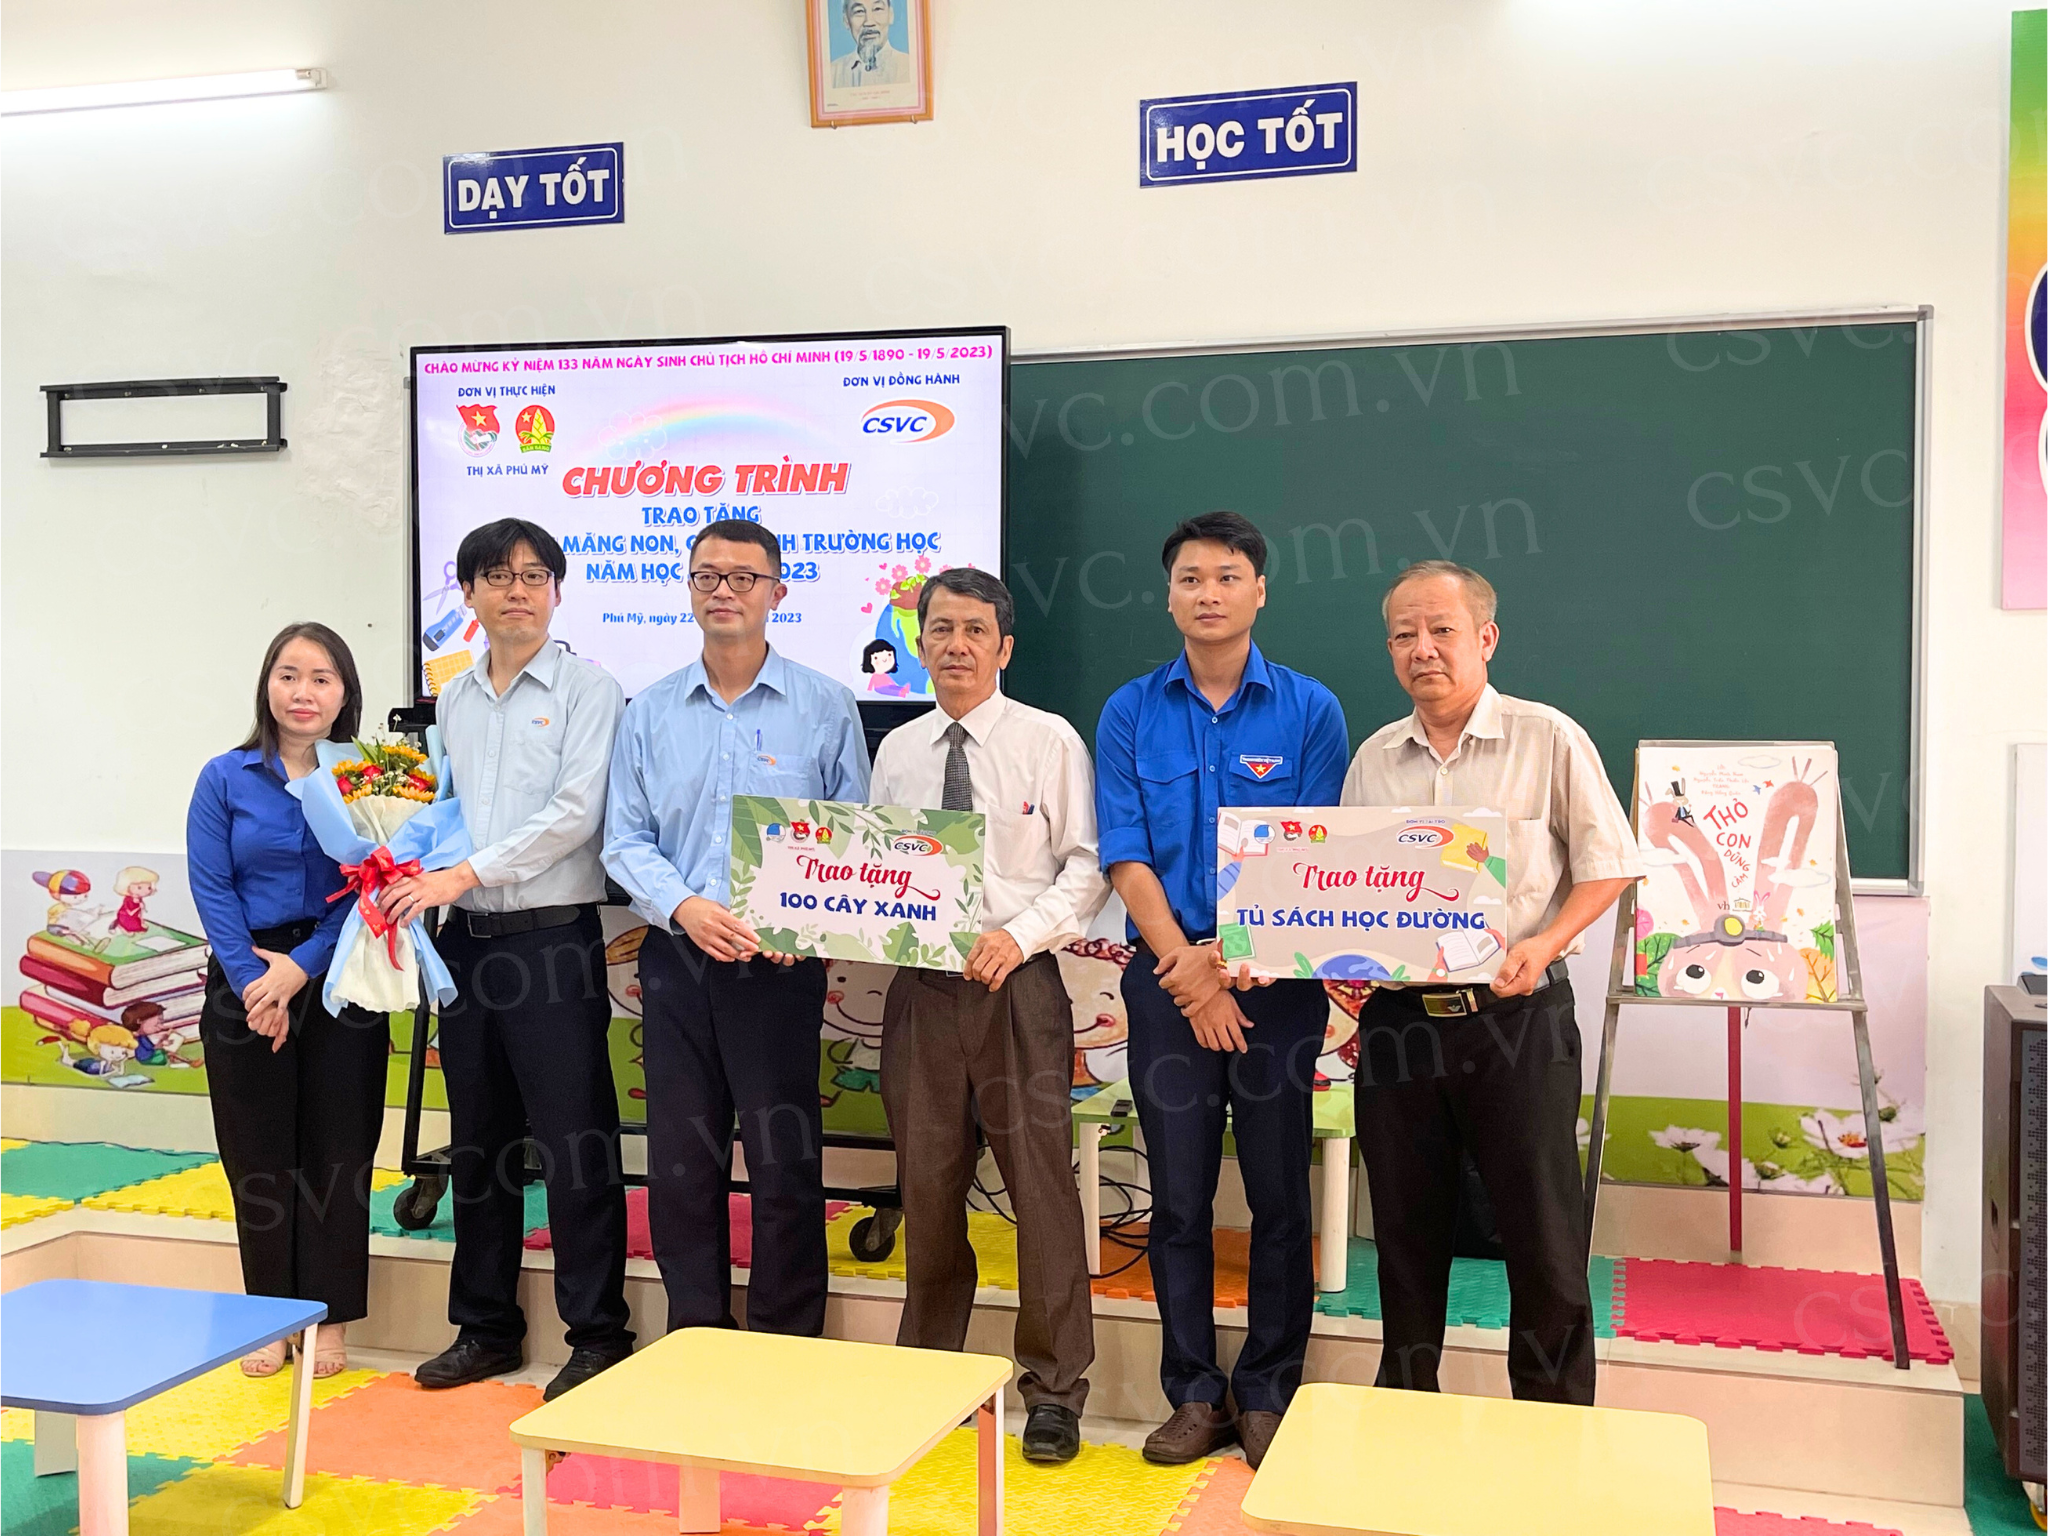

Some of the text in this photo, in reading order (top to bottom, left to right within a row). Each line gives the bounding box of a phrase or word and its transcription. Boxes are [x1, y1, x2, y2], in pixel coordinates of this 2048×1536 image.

[1157, 99, 1343, 170] HỌC TỐT
[458, 156, 609, 219] DẠY TỐT
[425, 361, 458, 374] CHÀO
[462, 359, 498, 373] MỪNG
[503, 357, 519, 371] KỶ
[524, 357, 554, 373] NIỆM
[558, 358, 578, 370] 133
[582, 356, 613, 369] NĂM
[616, 355, 652, 369] NGÀY
[657, 356, 686, 368] SINH
[690, 352, 714, 366] CHỦ
[719, 353, 746, 368] TỊCH
[750, 350, 768, 365] HỒ
[772, 350, 792, 364] CHÍ
[796, 350, 830, 362] MINH
[835, 349, 904, 363] (19/5/1890
[917, 345, 993, 360] 19/5/2023)
[458, 383, 555, 399] ĐƠN VỊ THỰC HIỆN
[843, 371, 960, 388] ĐƠN VỊ ĐỒNG HÀNH
[862, 416, 927, 434] CSVC
[467, 463, 548, 478] THỊ XÃ PHÚ MỸ
[562, 455, 849, 496] CHƯƠNG TRÌNH
[642, 506, 698, 524] TRAO
[563, 532, 624, 553] MĂNG
[631, 535, 680, 554] NON,
[803, 530, 890, 551] TRƯỜNG
[896, 531, 939, 554] HỌC
[586, 560, 635, 581] NĂM
[641, 563, 681, 584] HỌC
[603, 612, 801, 626] Phú Mỹ, ngày 22 2023
[1703, 798, 1748, 831] THỎ
[894, 842, 928, 852] CSVC
[1398, 834, 1437, 843] CSVC
[1716, 832, 1751, 849] CON
[1724, 849, 1750, 872] DŨNG
[796, 855, 941, 901] Trao tặng
[1293, 862, 1459, 902] Trao tặng
[780, 892, 937, 921] 100 CÂY XANH
[1236, 904, 1485, 931] TỦ SÁCH HỌC ĐƯỜNG
